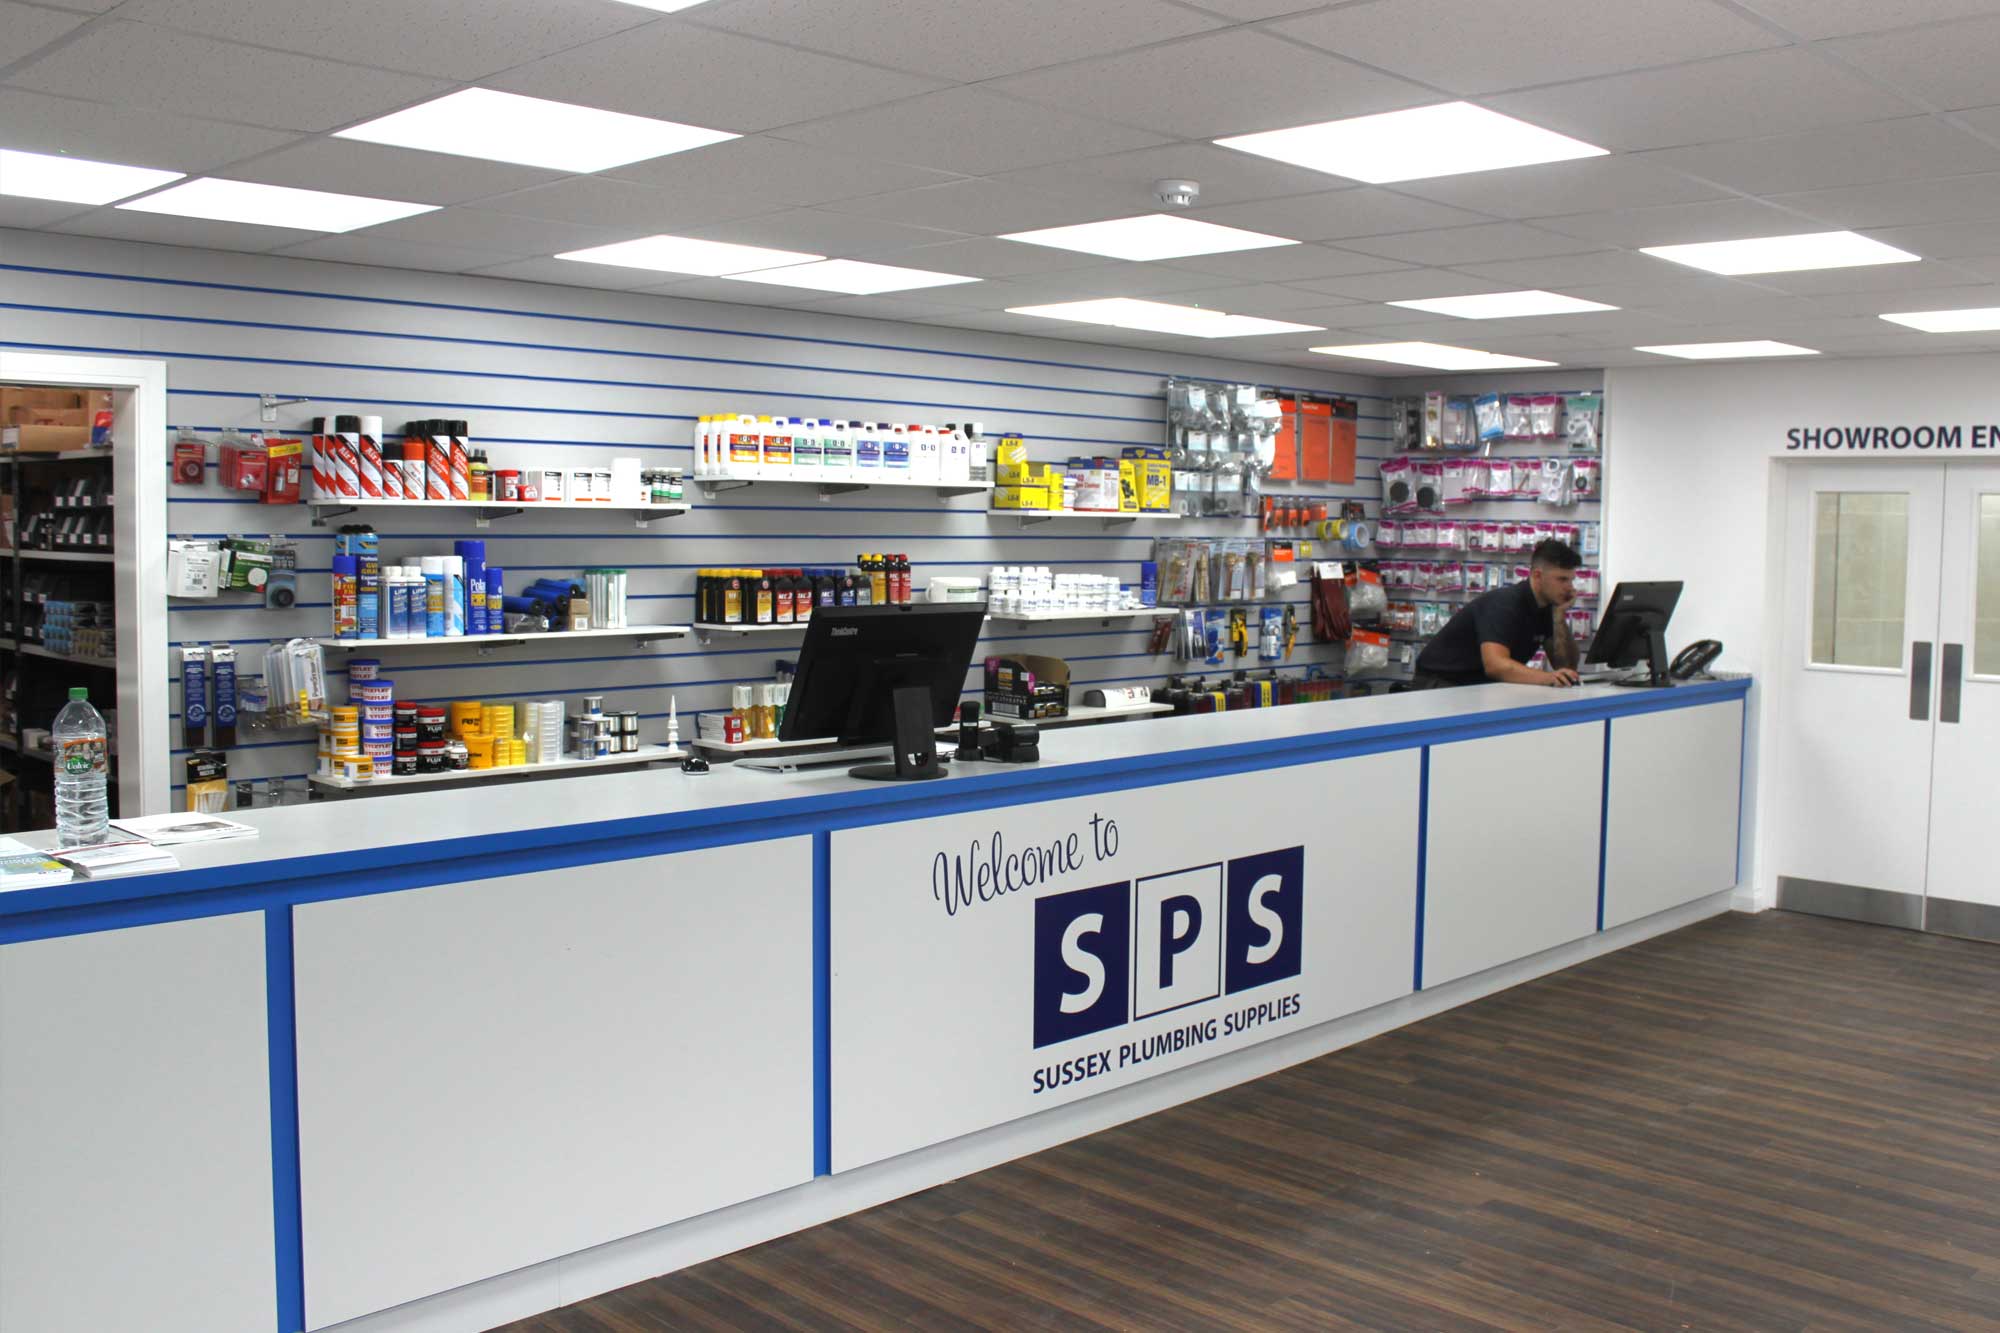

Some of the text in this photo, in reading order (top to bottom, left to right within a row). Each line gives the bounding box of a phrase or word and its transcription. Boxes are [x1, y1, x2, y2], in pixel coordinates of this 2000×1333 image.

[1786, 425, 1962, 450] SHOWROOM
[932, 812, 1119, 917] Welcome to
[1032, 993, 1302, 1095] SUSSEX PLUMBING SUPPLIES
